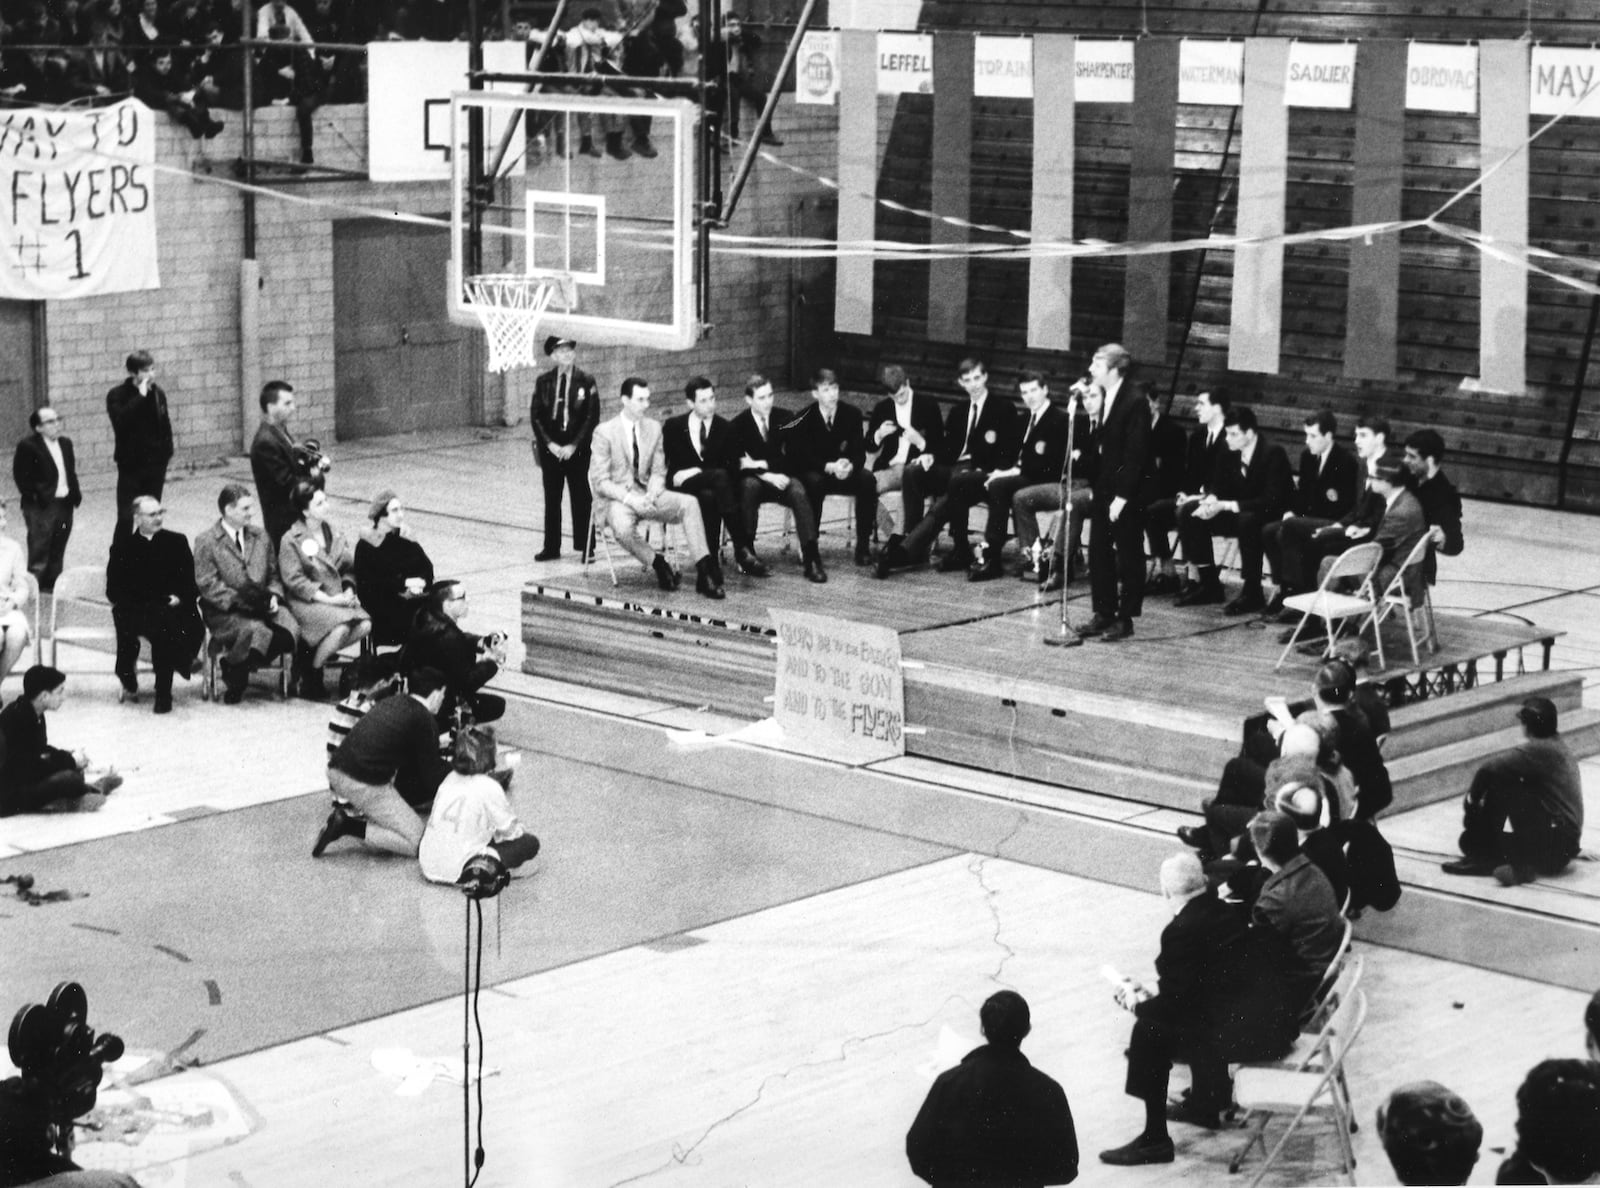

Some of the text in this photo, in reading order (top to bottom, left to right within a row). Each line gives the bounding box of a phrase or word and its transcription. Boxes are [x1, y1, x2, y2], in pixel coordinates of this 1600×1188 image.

[880, 53, 931, 73] LEFFEL
[976, 59, 1033, 78] TORAIN
[1075, 61, 1135, 80] SHARPENTER
[1181, 64, 1240, 86] WATERMAN
[1290, 62, 1350, 84] SADLIER
[1409, 66, 1475, 90] OBROVAC
[1537, 64, 1595, 98] MAY
[85, 104, 139, 147] TO
[11, 163, 149, 226] FLYERS
[785, 655, 892, 701] AND TO THE SON
[784, 690, 808, 715] AND
[812, 694, 827, 721] TO
[851, 703, 902, 747] FLYERS
